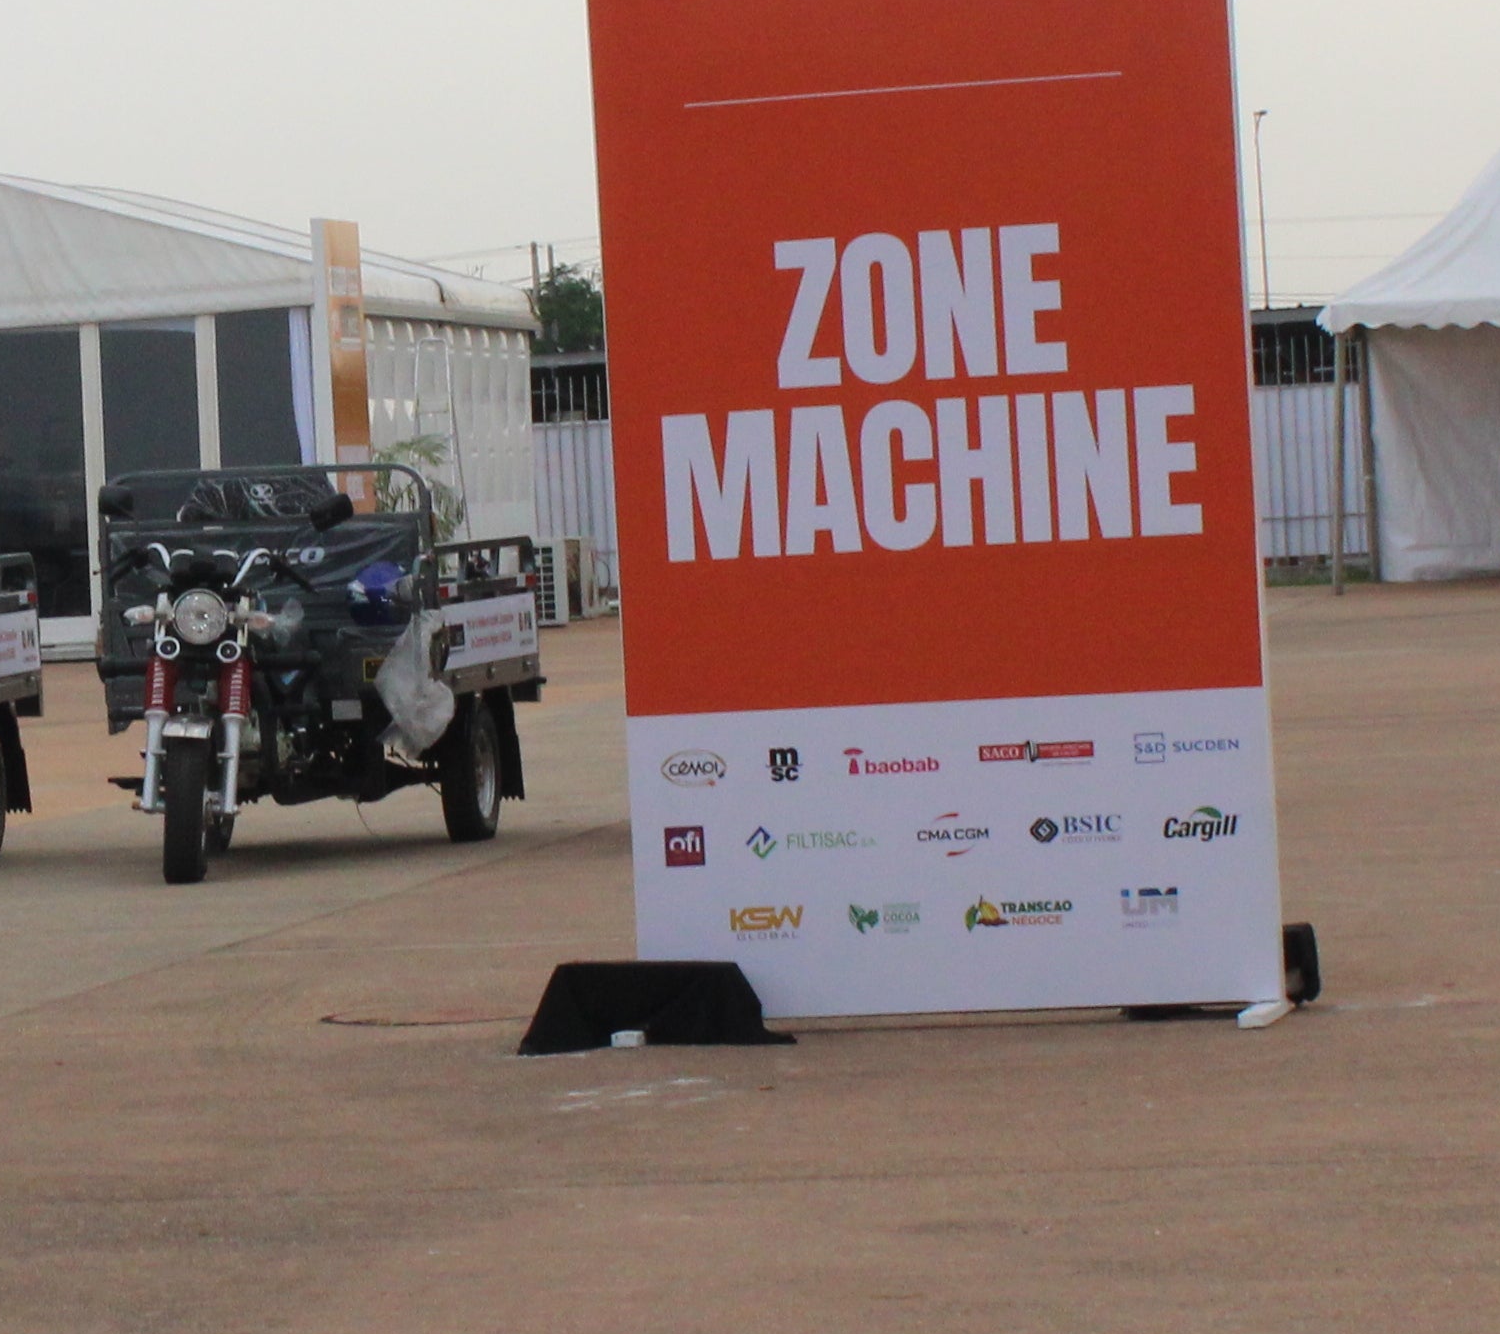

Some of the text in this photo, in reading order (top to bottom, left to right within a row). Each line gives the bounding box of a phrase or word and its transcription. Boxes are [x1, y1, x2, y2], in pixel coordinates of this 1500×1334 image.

[773, 222, 1068, 389] ZONE
[661, 383, 1203, 562] MACHINE
[981, 746, 1020, 759] SACO
[1134, 742, 1166, 754] S&D
[1173, 739, 1240, 753] SUCDEN
[865, 756, 940, 775] baobab
[1063, 815, 1121, 833] BSIC
[1163, 815, 1238, 842] Cargill
[787, 831, 857, 850] FILTISAC
[917, 828, 989, 842] CMA CGM
[1001, 900, 1072, 914] TRANSCAO
[730, 905, 804, 932] KSW
[883, 911, 920, 924] COCOA
[736, 931, 798, 942] GLOBAL
